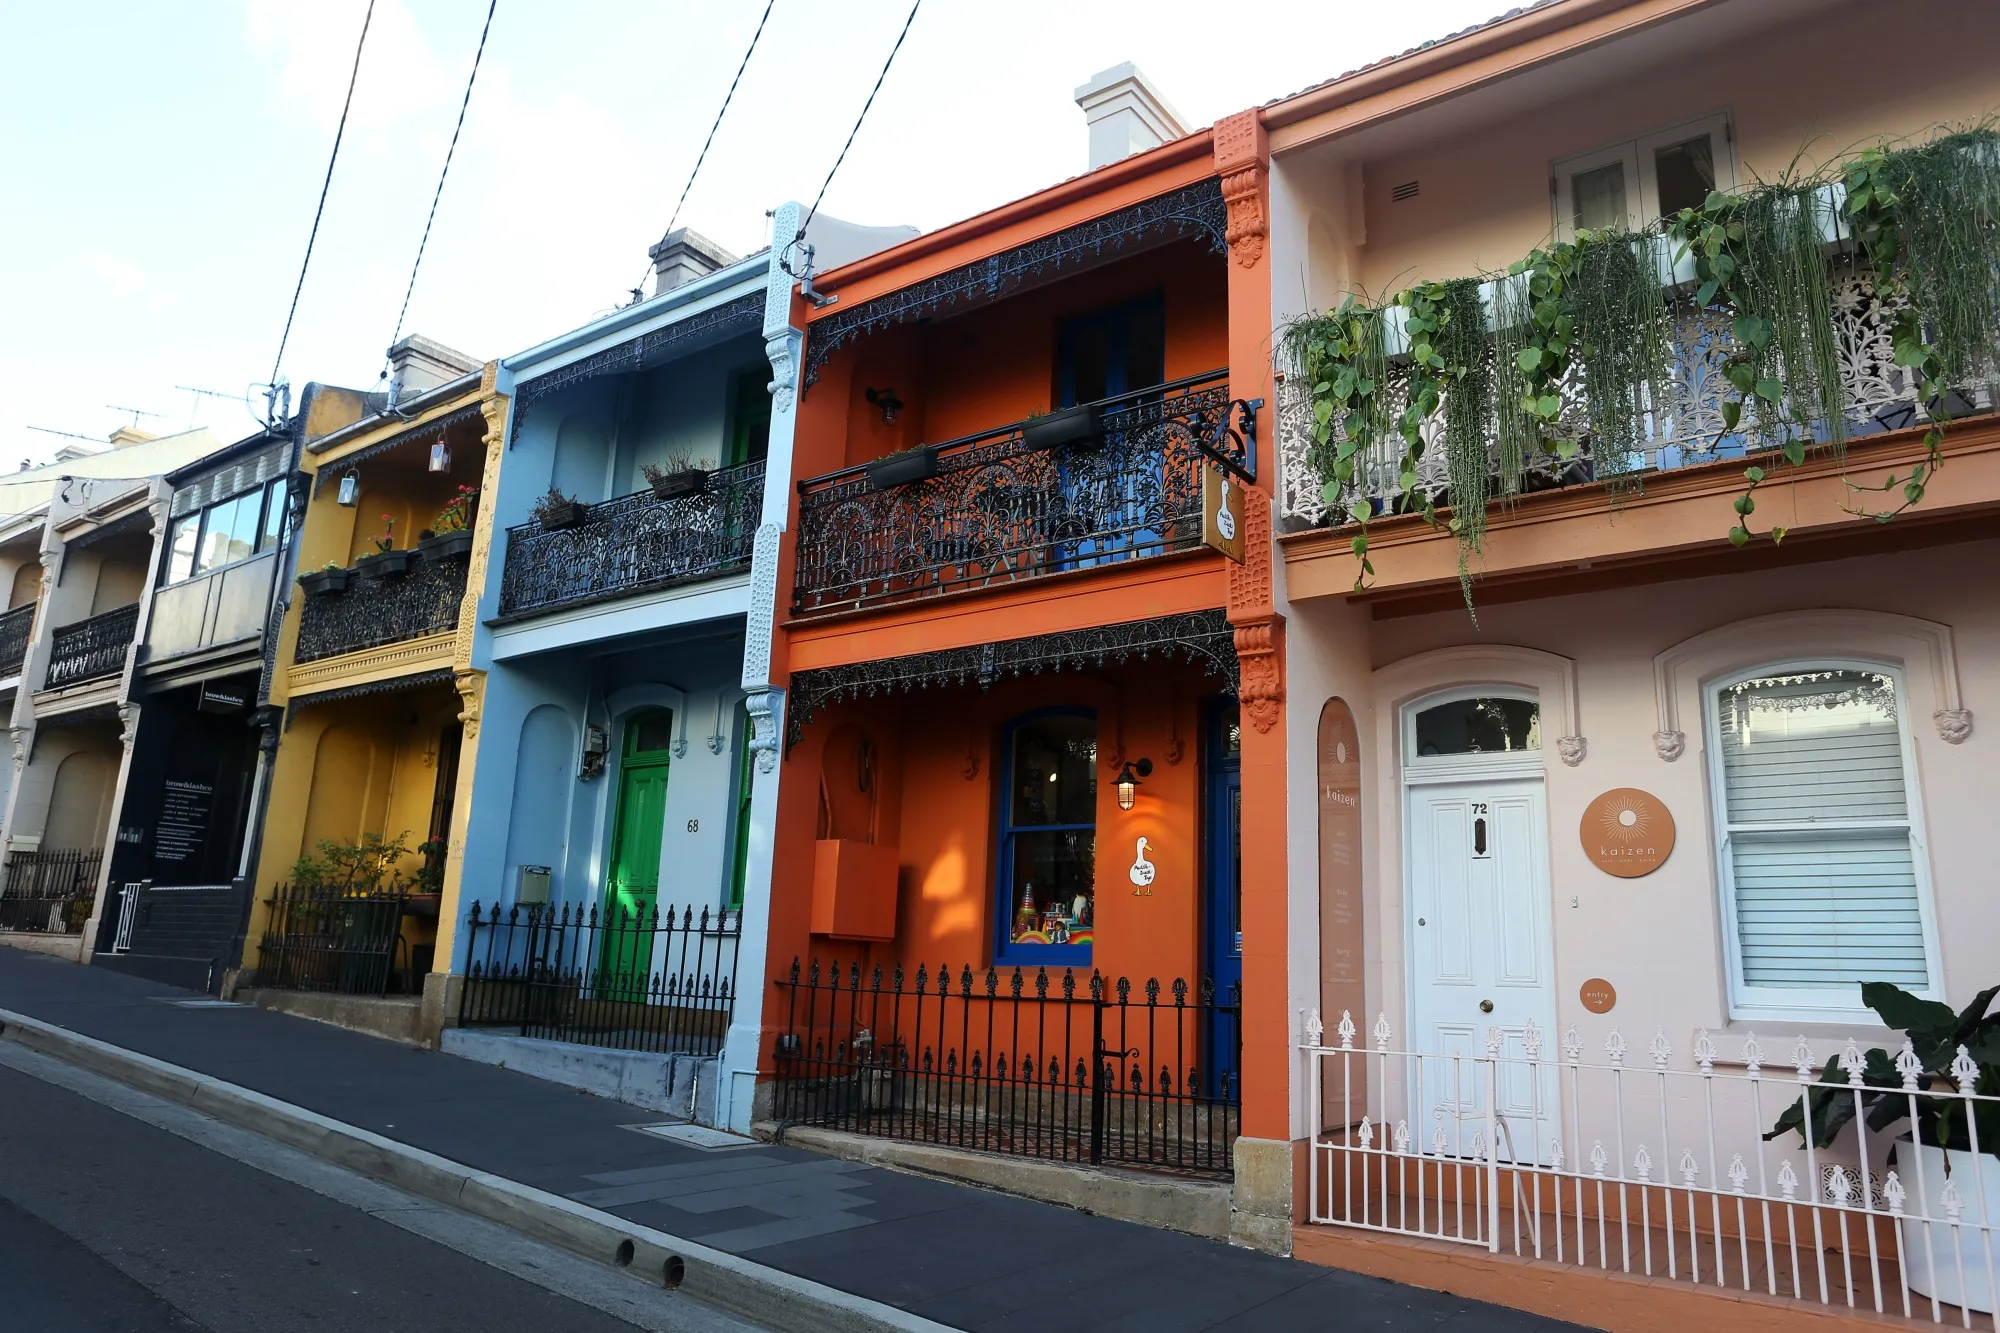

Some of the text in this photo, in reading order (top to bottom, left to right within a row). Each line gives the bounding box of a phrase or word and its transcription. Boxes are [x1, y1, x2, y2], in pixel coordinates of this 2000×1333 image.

[165, 780, 213, 791] brow&lashco
[1326, 784, 1355, 807] kaizen
[1471, 803, 1488, 815] 72
[687, 819, 699, 833] 68
[1600, 846, 1655, 856] kaizen
